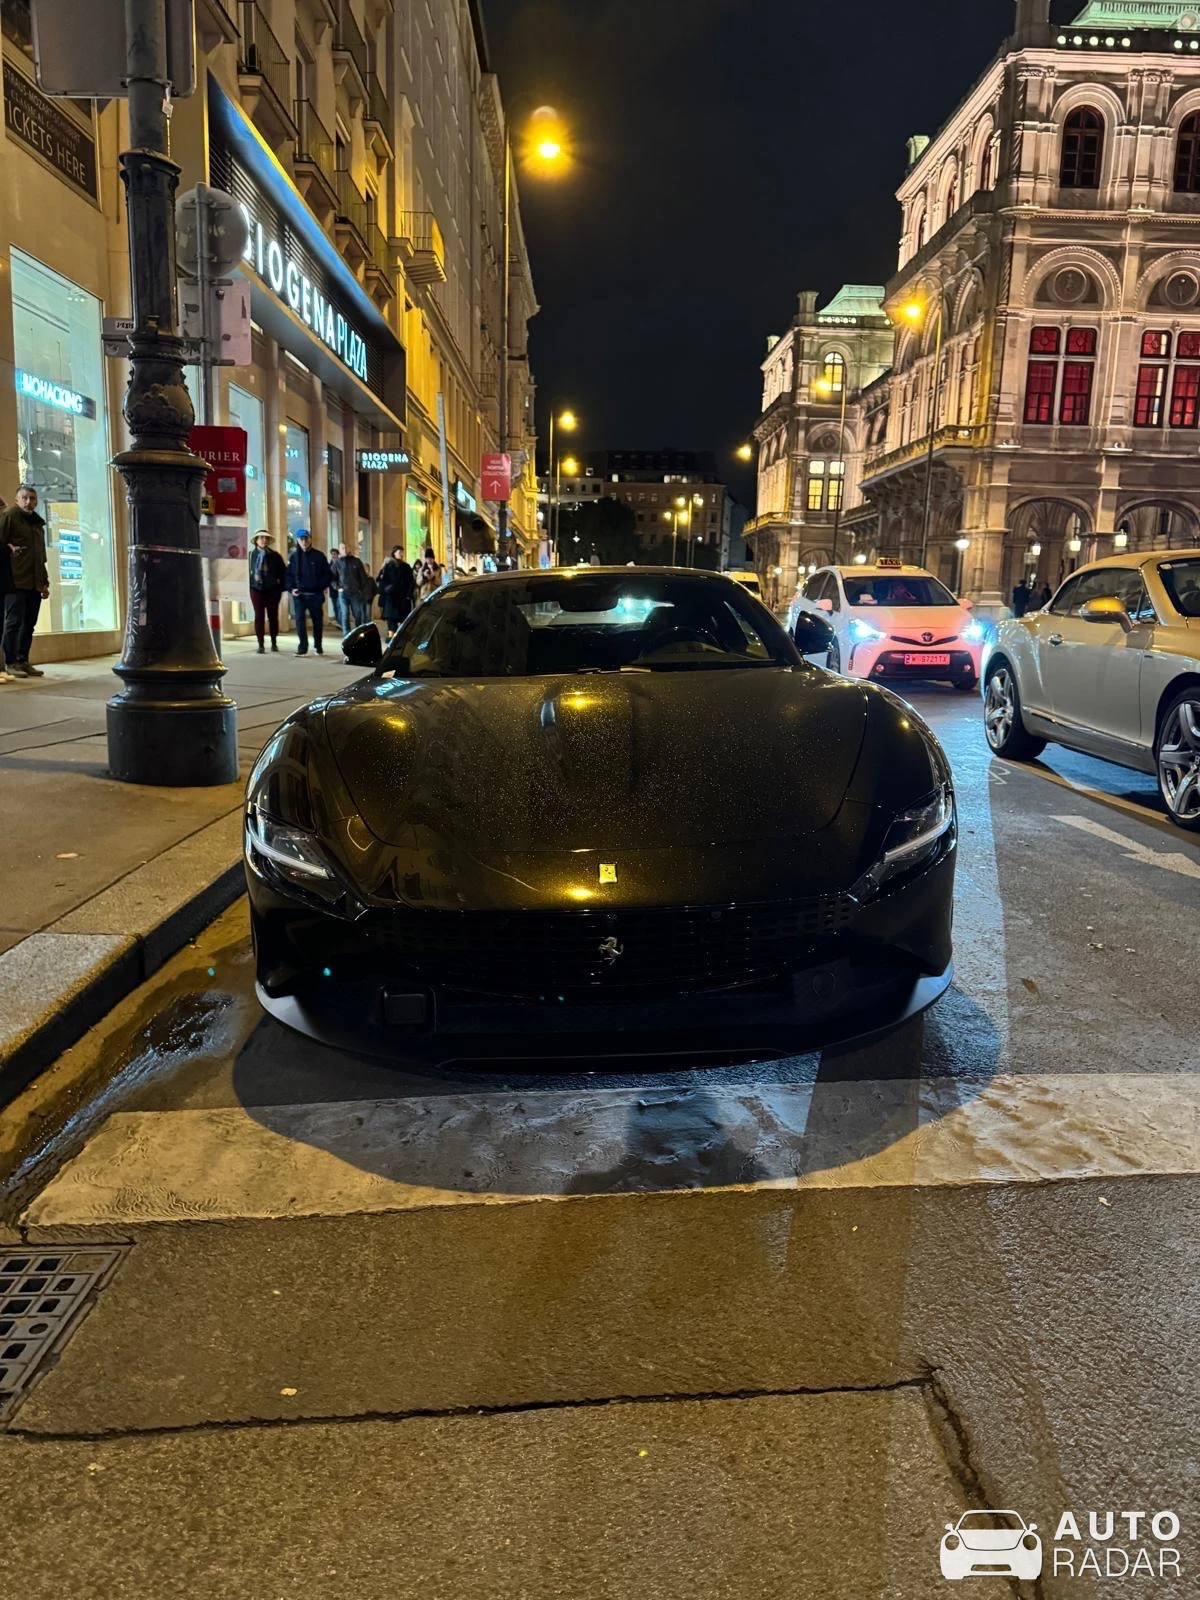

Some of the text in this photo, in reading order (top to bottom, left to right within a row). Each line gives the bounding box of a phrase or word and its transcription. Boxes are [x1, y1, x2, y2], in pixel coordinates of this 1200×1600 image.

[5, 97, 53, 156] ICKETS
[57, 141, 86, 185] HERE
[336, 312, 368, 382] PLAZA
[362, 452, 409, 463] BIOGENA
[362, 461, 388, 470] PLAZA
